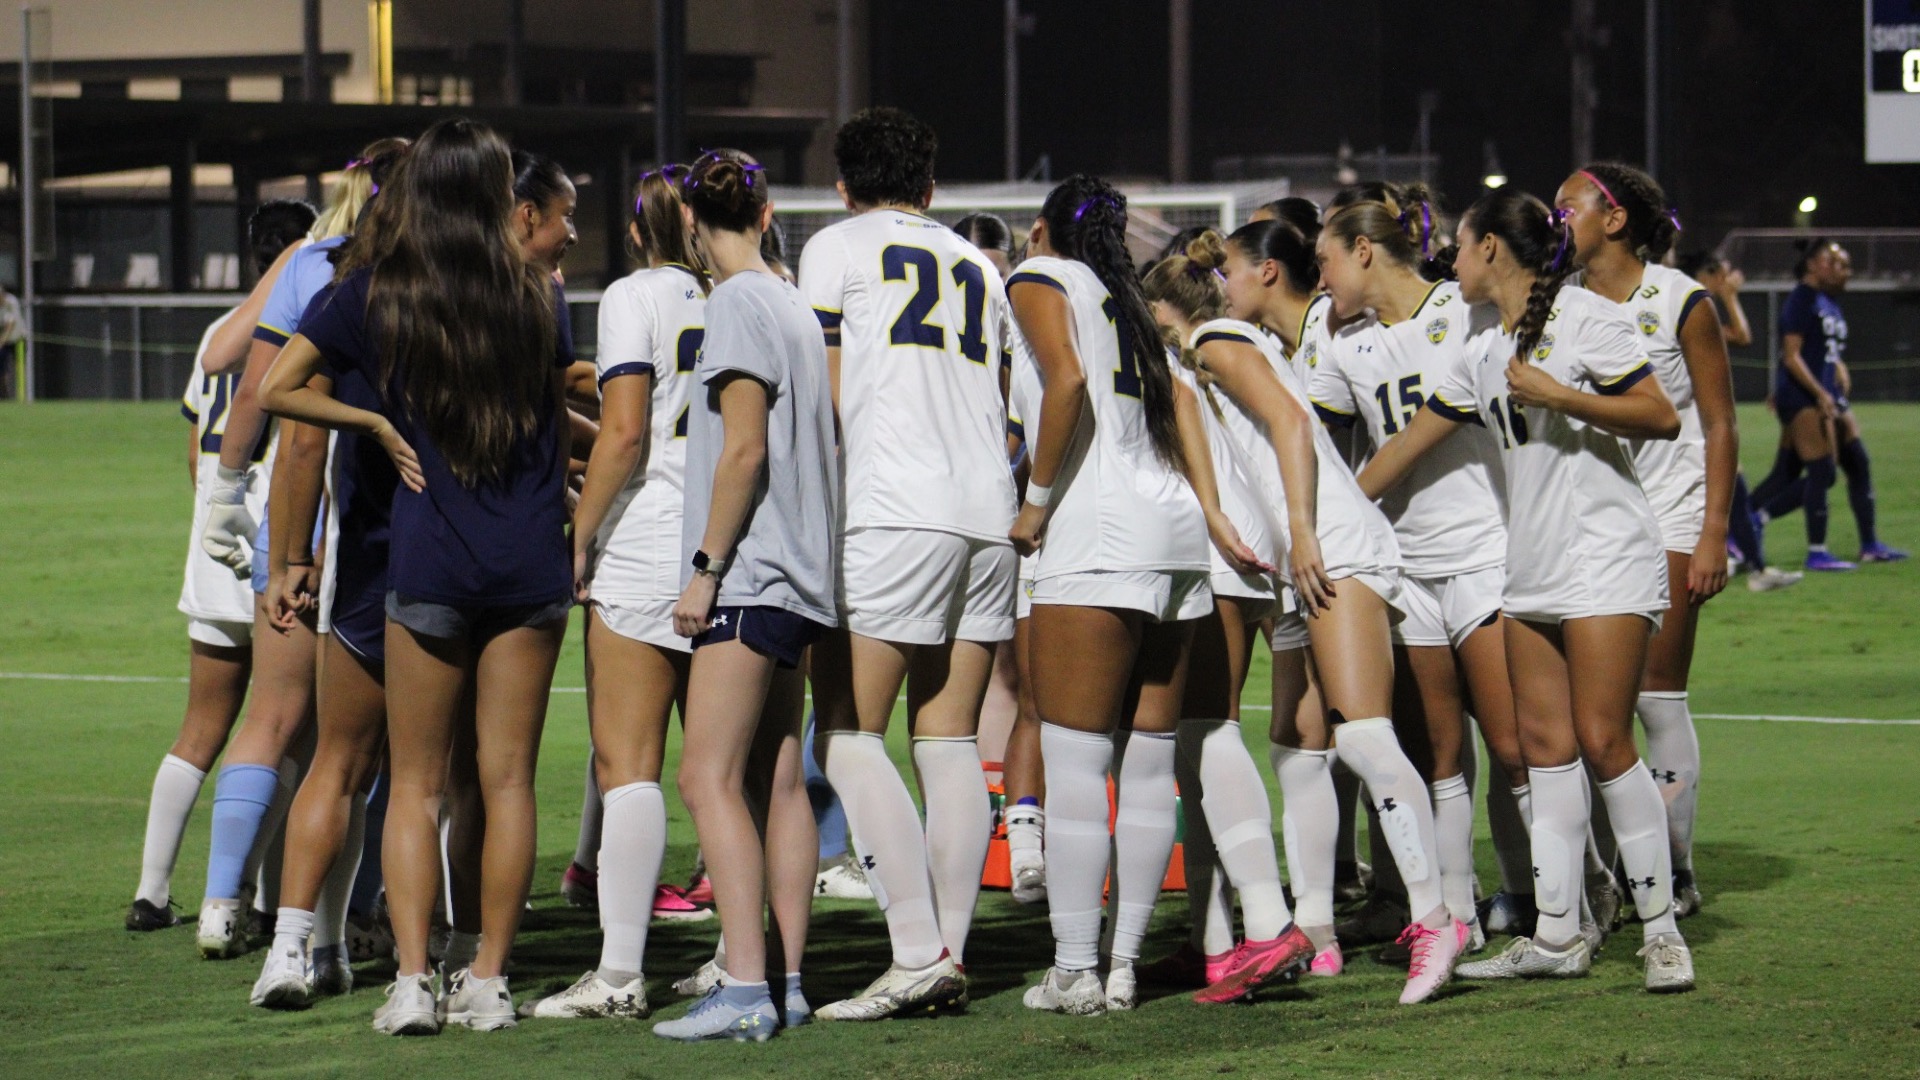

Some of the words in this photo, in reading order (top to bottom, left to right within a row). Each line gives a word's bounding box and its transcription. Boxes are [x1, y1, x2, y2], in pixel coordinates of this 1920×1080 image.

[880, 240, 988, 366] 21
[1375, 371, 1426, 437] 15
[1488, 393, 1530, 451] 16
